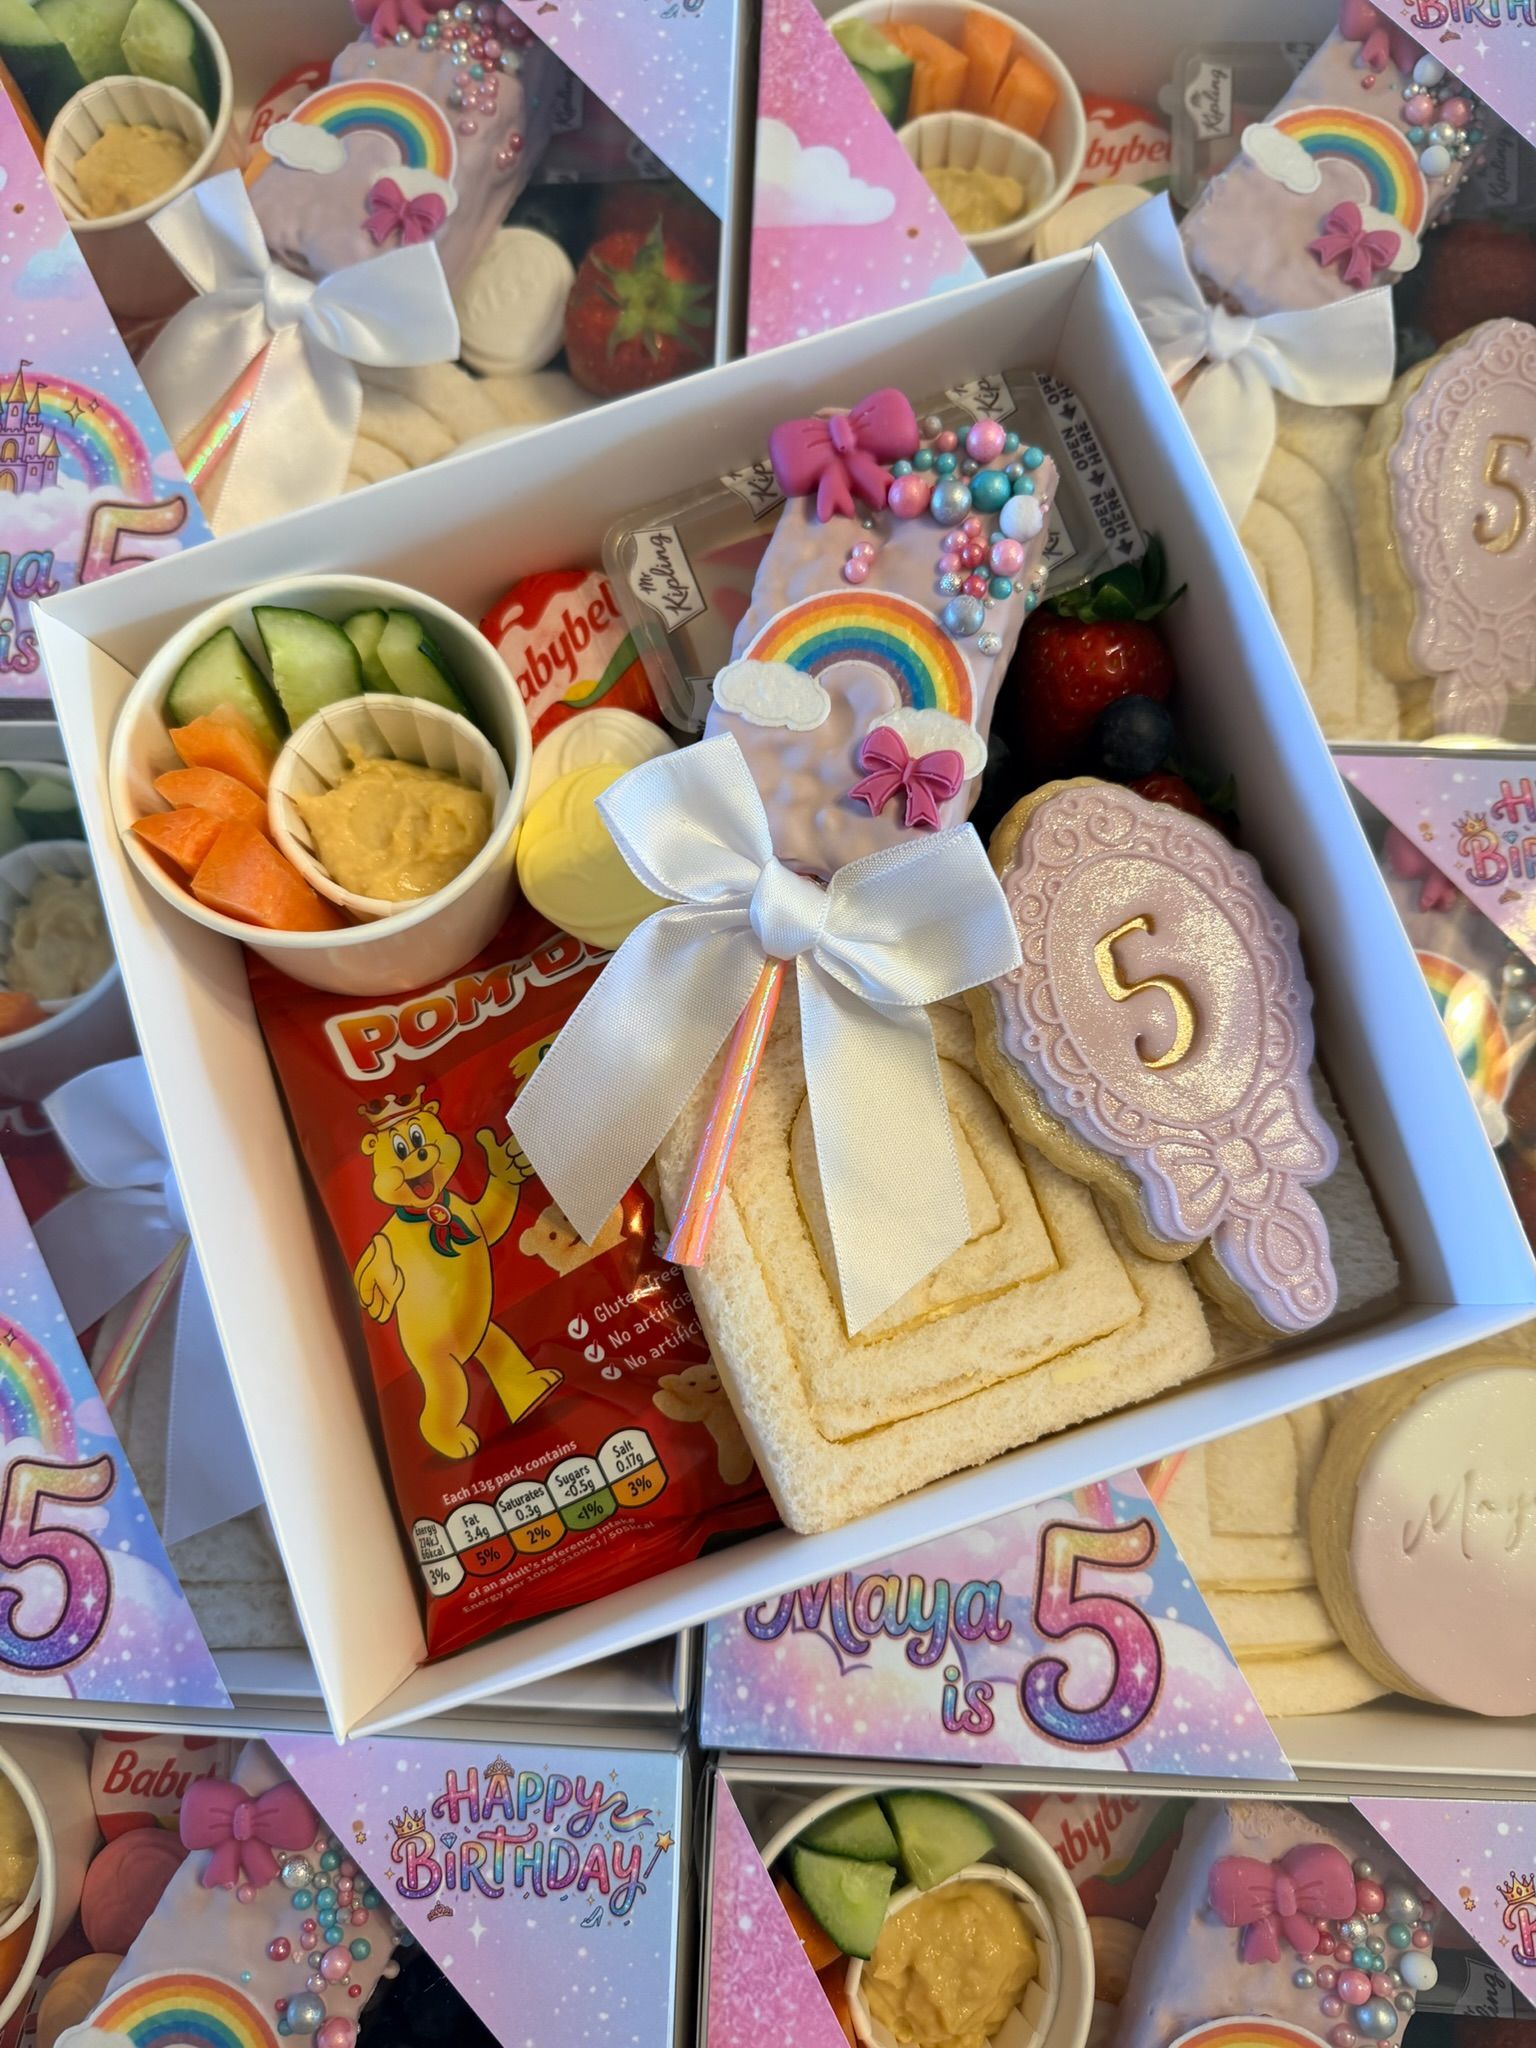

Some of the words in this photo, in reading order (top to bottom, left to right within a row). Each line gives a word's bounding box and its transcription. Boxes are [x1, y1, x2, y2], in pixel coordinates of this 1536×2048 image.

[1061, 426, 1089, 471] OPEN
[1075, 421, 1102, 467] HERE
[1472, 432, 1532, 553] 5
[1089, 493, 1117, 539] OPEN
[1103, 487, 1131, 535] HERE
[639, 571, 655, 595] Mr
[651, 531, 692, 615] Kipling
[1094, 912, 1202, 1071] 5
[608, 1328, 631, 1349] No
[624, 1354, 647, 1370] No
[612, 1440, 634, 1458] Salt
[442, 1487, 471, 1506] Each
[471, 1479, 496, 1496] 13g
[495, 1464, 525, 1487] pack
[525, 1440, 577, 1472] contains
[616, 1453, 644, 1473] 0.17g
[555, 1465, 591, 1488] Sugars
[564, 1479, 596, 1497] <0.5g
[628, 1475, 652, 1497] 3%
[498, 1486, 545, 1513] Saturates
[577, 1501, 604, 1520] <1%
[461, 1513, 480, 1528] Fat
[515, 1503, 541, 1522] 0.3g
[465, 1525, 491, 1543] 3.4g
[526, 1524, 552, 1545] 2%
[0, 1454, 116, 1676] 5
[468, 1586, 482, 1600] of
[482, 1581, 498, 1594] an
[499, 1562, 540, 1585] adult's
[541, 1533, 597, 1565] reference
[597, 1518, 636, 1535] intake
[476, 1546, 501, 1567] 5%
[429, 1567, 451, 1586] 3%
[462, 1590, 504, 1614] Energy
[505, 1579, 525, 1594] per
[744, 1571, 1013, 1669] Maya
[941, 1665, 996, 1736] is
[1018, 1516, 1166, 1753] 5
